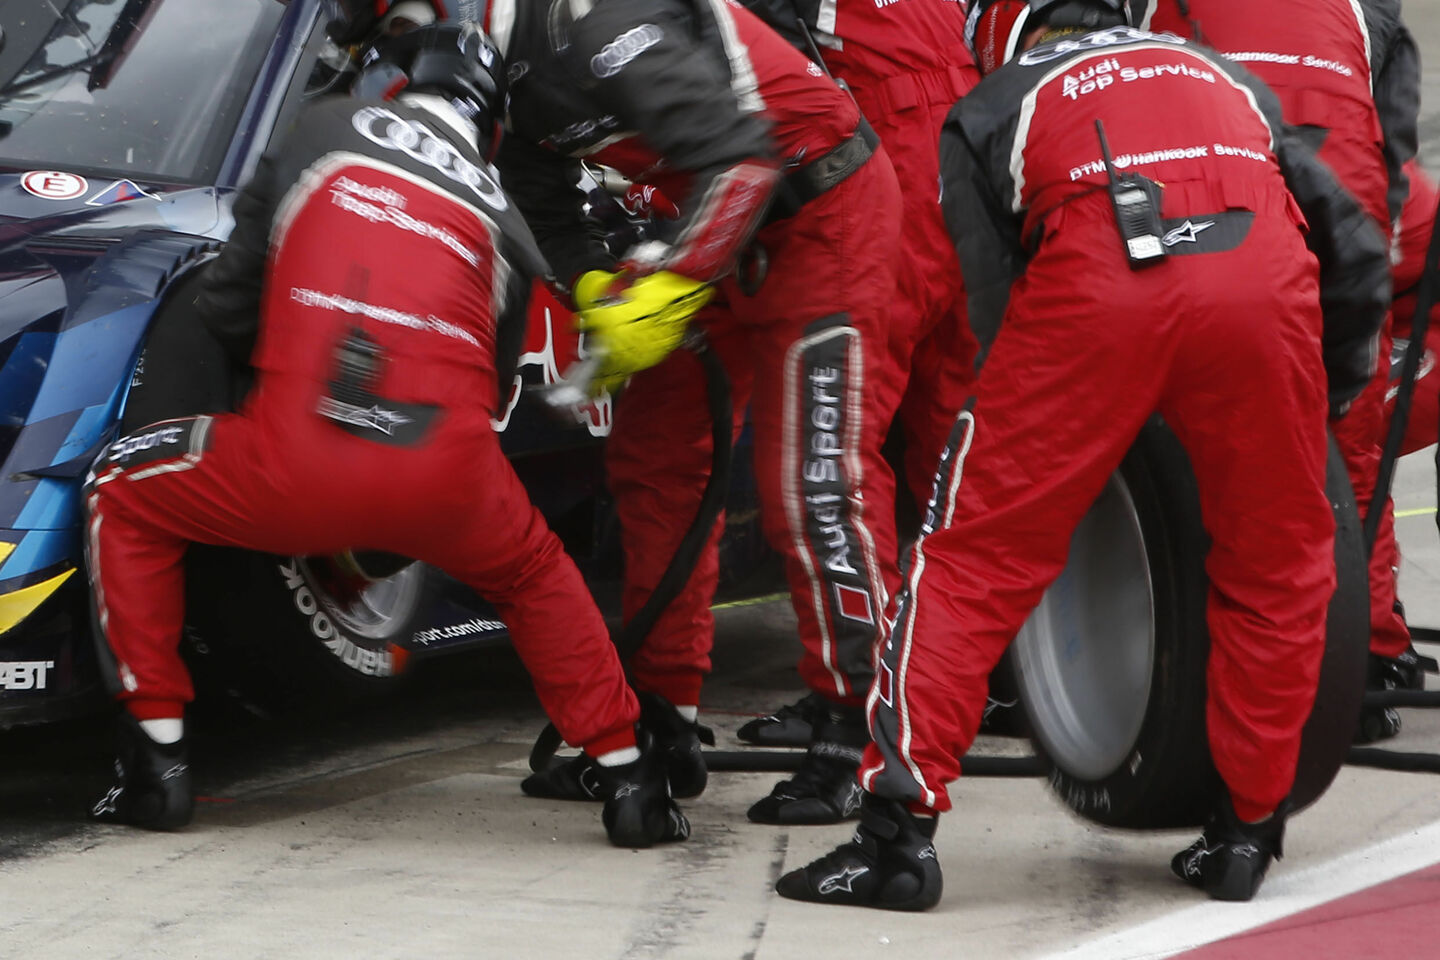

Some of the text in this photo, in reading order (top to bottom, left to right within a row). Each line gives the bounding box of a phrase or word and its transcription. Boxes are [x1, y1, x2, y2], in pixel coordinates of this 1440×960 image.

[1062, 57, 1120, 90] Audi
[1062, 63, 1216, 101] Top Service
[1213, 143, 1268, 163] Service
[803, 366, 859, 576] Audi Sport
